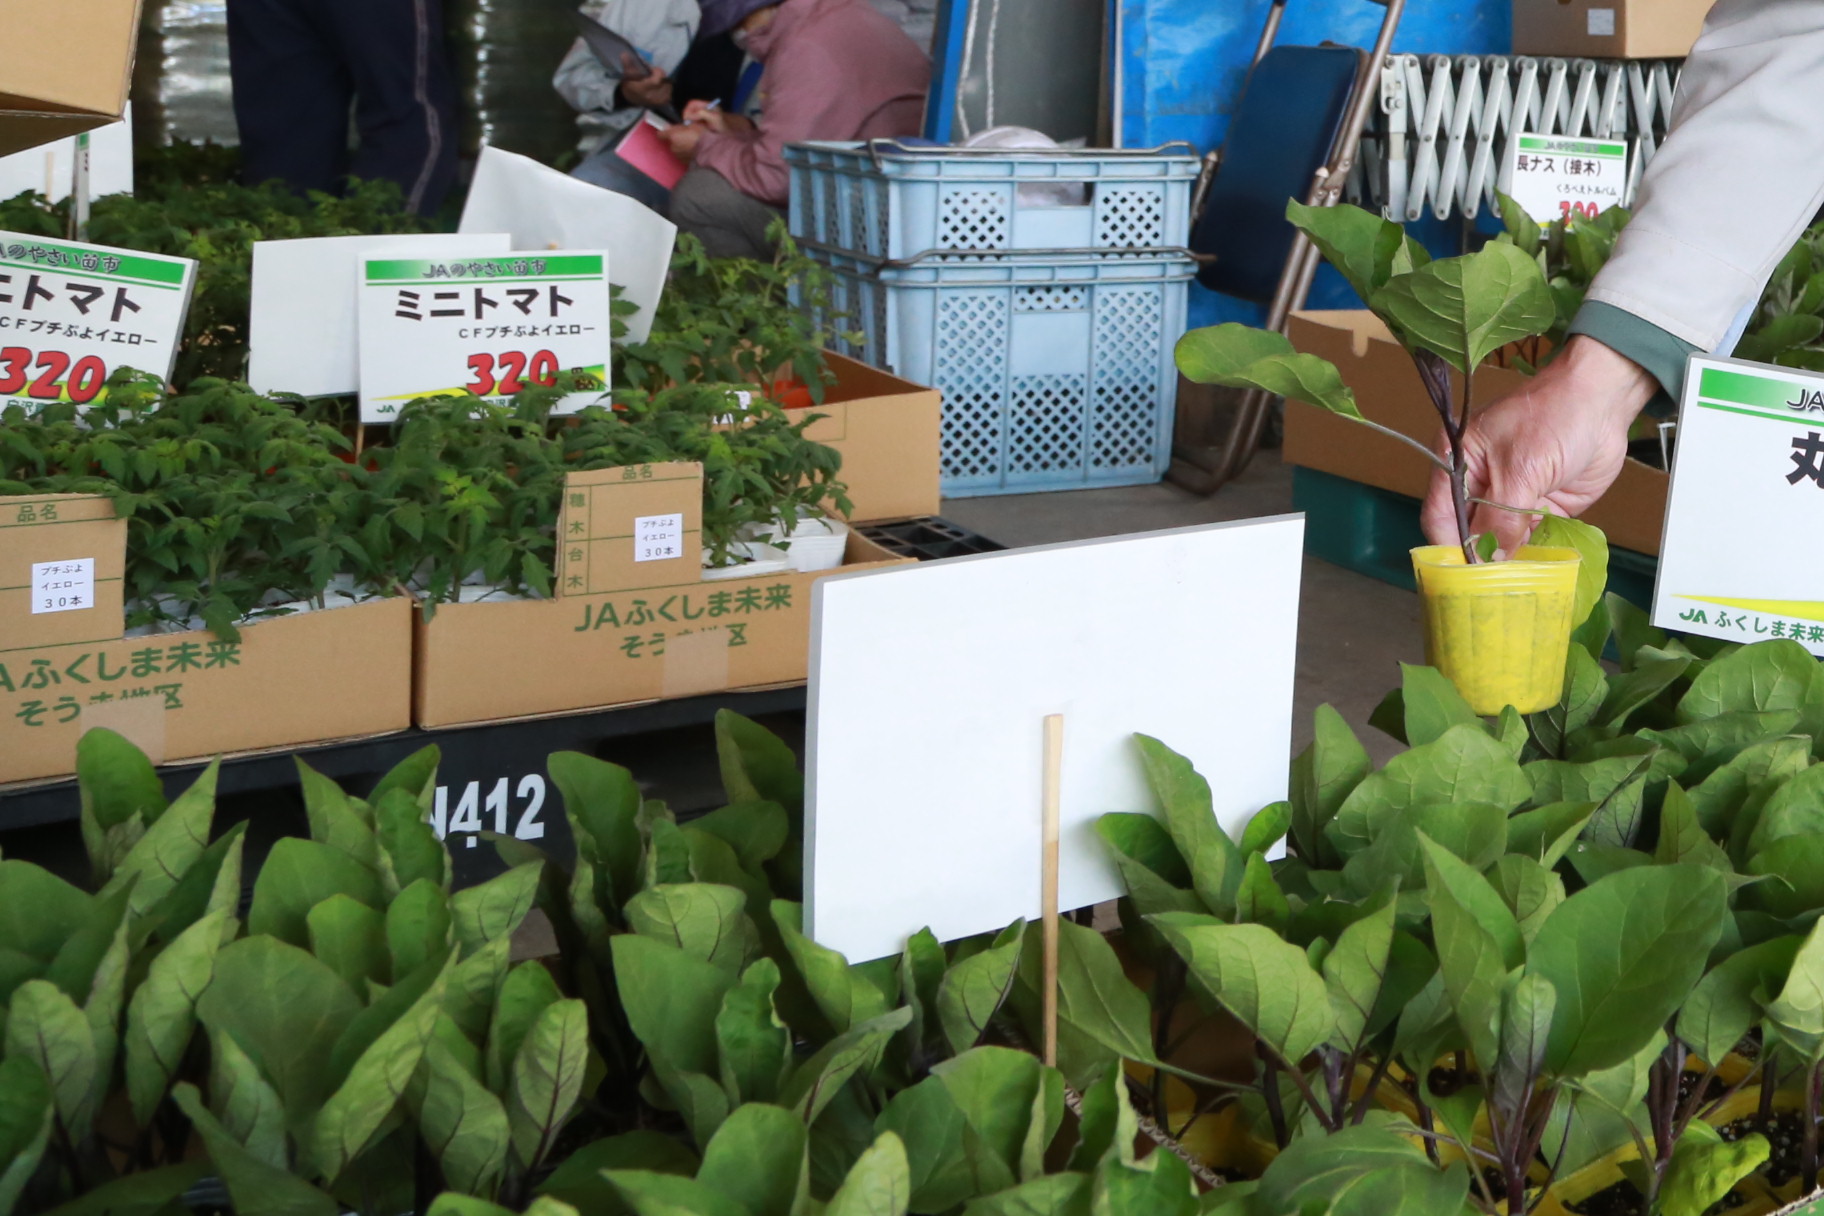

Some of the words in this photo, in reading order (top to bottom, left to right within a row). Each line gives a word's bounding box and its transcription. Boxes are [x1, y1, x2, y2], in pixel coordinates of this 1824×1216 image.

[395, 285, 573, 321] ミニトマト
[0, 346, 107, 403] 320
[466, 349, 559, 396] 320
[622, 464, 653, 480] 品名
[17, 503, 58, 523] 品名
[642, 533, 675, 542] イエロー
[41, 581, 85, 590] イエロー
[44, 596, 83, 609] 30本
[574, 583, 792, 632] JAふくしま未来
